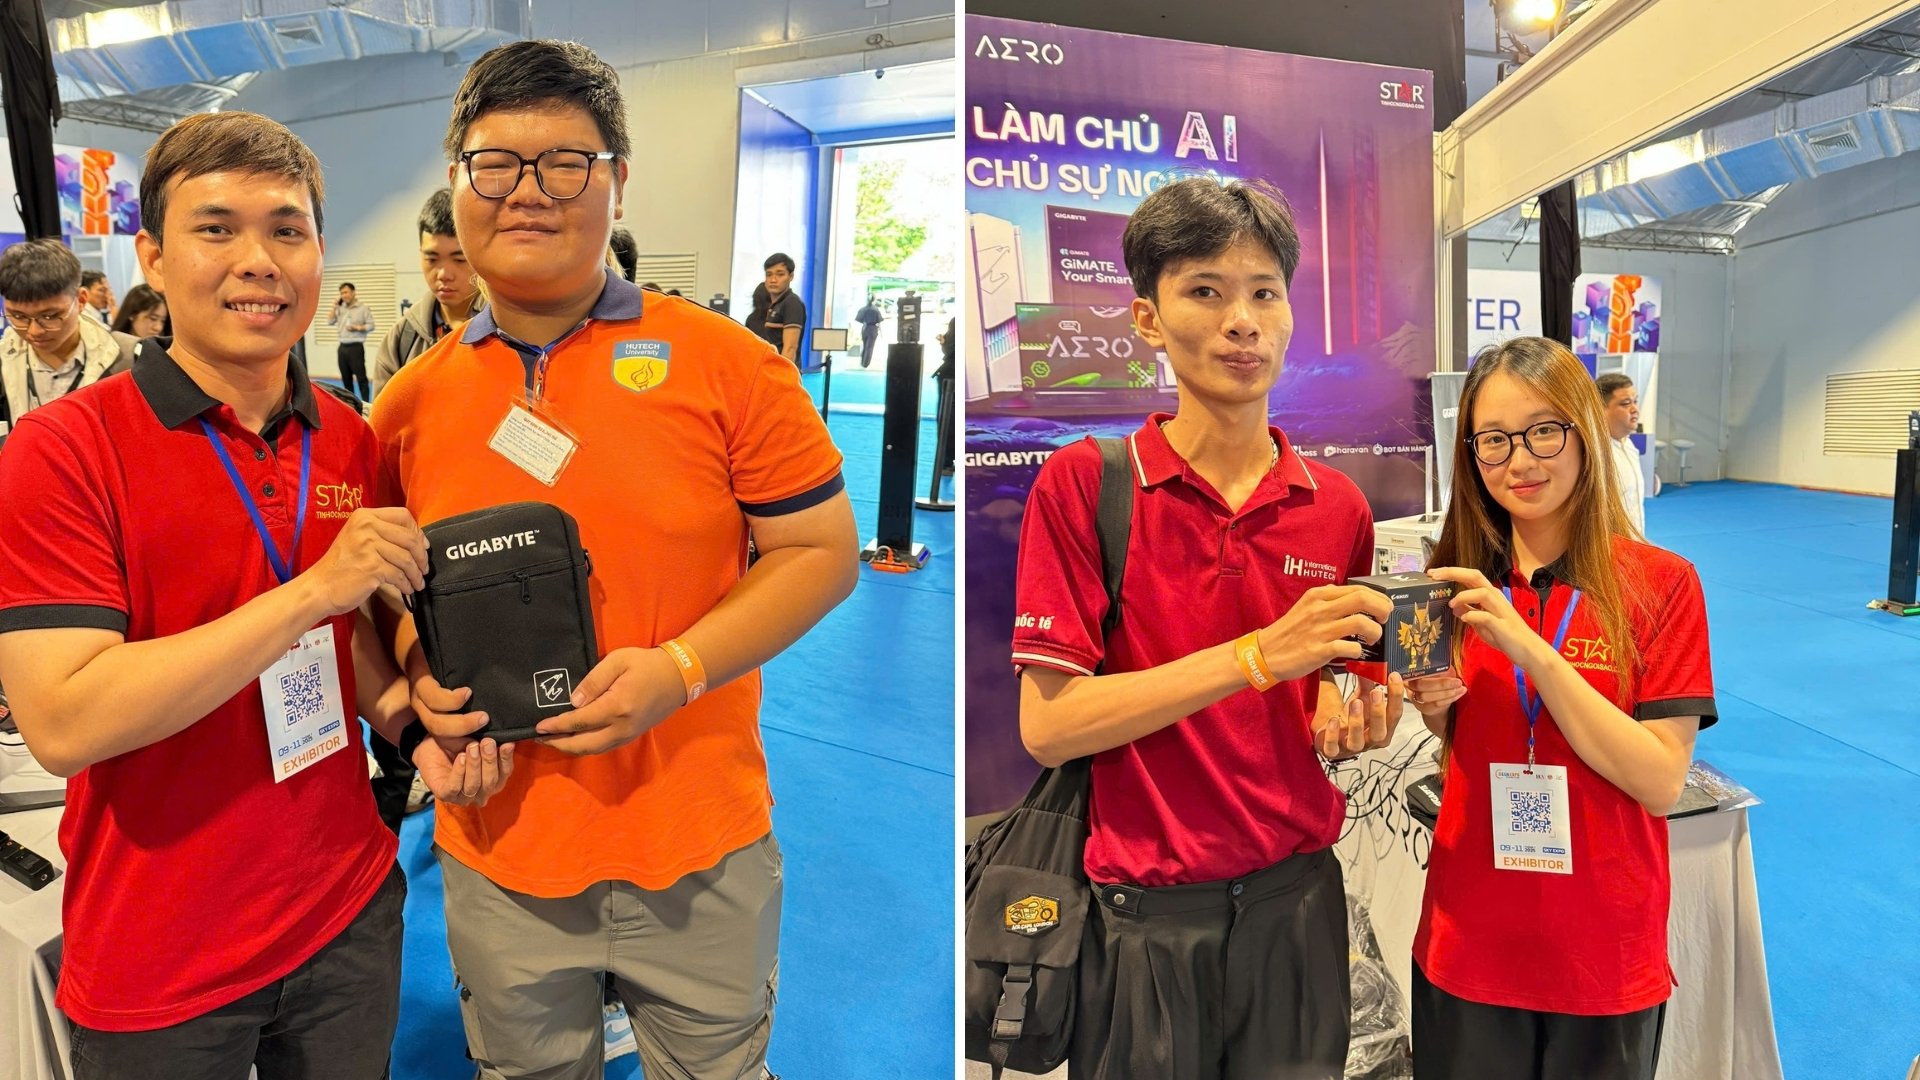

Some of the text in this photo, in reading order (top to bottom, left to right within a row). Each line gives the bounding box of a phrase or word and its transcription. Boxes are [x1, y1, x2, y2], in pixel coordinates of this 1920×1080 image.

[975, 35, 1064, 65] AERO
[973, 102, 1238, 162] LÀM CHỦ AI
[966, 153, 1049, 191] CHỦ
[1058, 163, 1111, 200] SỰ
[1054, 212, 1087, 221] GIGABYTE
[1061, 271, 1094, 282] Your
[1468, 299, 1521, 330] ER
[1047, 335, 1133, 358] AERO
[1336, 446, 1369, 454] haravan
[1303, 569, 1336, 581] HUTECH
[1015, 612, 1056, 630] uốc tế
[679, 648, 693, 669] EXPO
[1564, 636, 1614, 662] STA
[1253, 668, 1268, 684] EXPO
[283, 735, 341, 773] EXHIBITOR
[1503, 856, 1564, 870] EXHIBITOR
